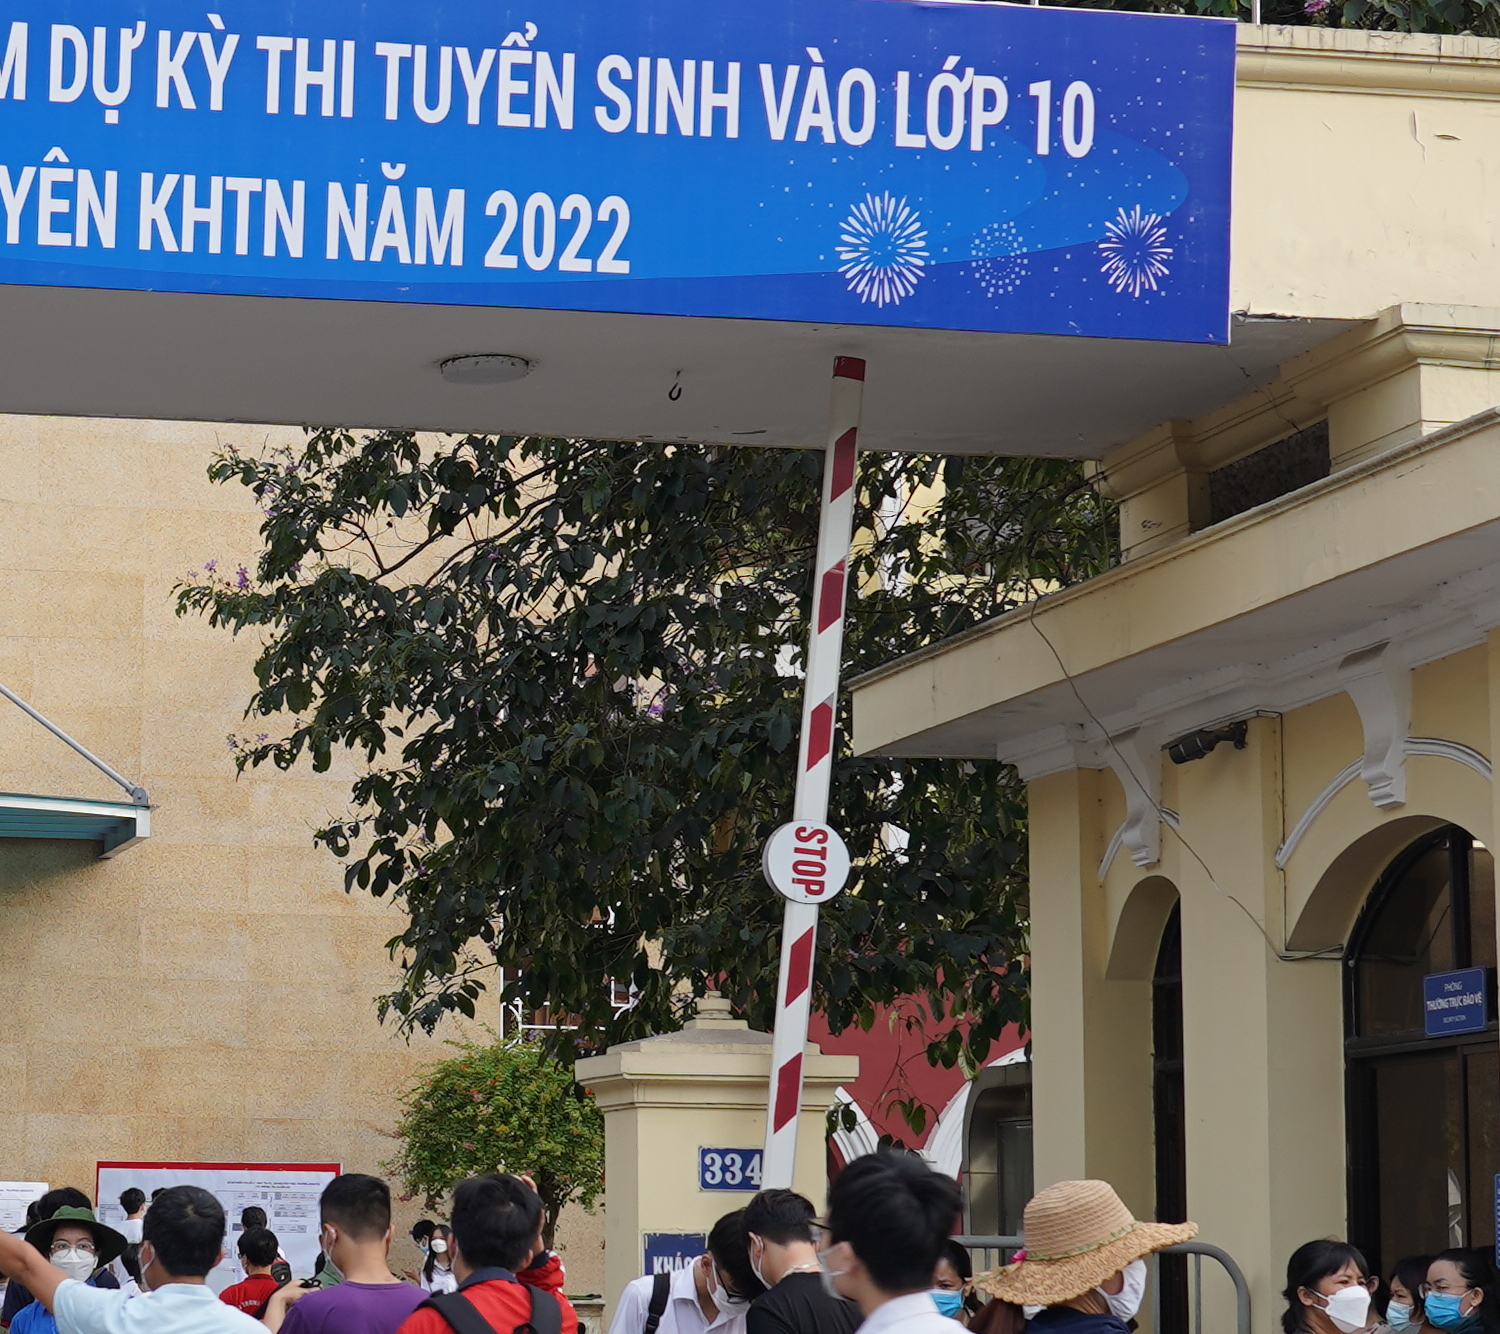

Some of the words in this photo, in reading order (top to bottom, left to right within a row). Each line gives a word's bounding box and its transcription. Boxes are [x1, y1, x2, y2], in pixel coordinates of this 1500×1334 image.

[49, 20, 146, 124] DỰ
[155, 13, 239, 111] KỲ
[256, 36, 355, 118] THI
[375, 22, 576, 130] TUYỂN
[594, 53, 741, 138] SINH
[759, 47, 876, 147] VÀO
[894, 55, 1009, 152] LỚP
[1028, 79, 1095, 158] 10
[138, 172, 306, 258] KHTN
[326, 162, 465, 266] NĂM
[484, 188, 631, 274] 2022
[792, 826, 829, 896] STOP
[704, 1152, 762, 1185] 334
